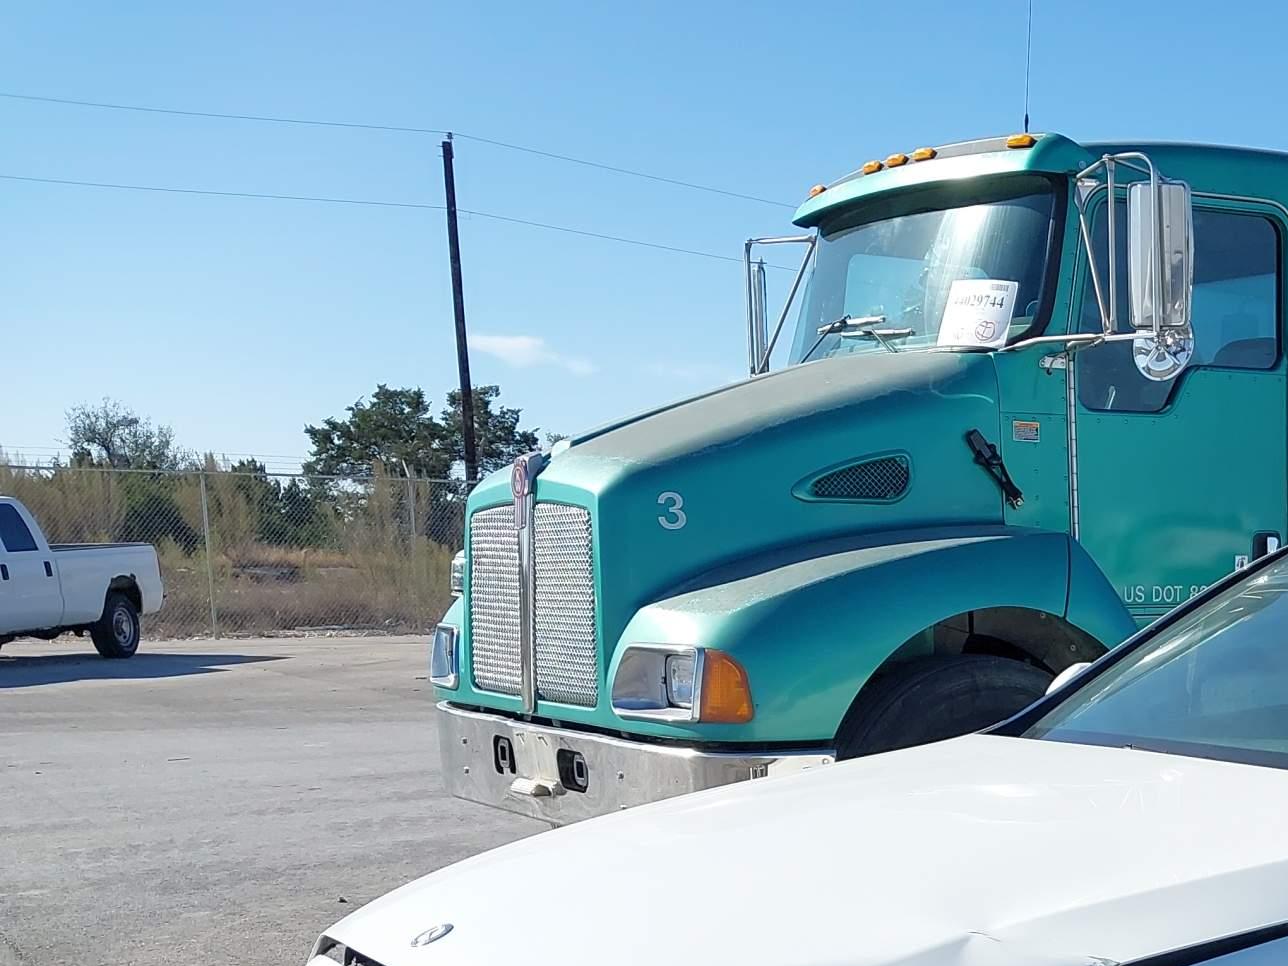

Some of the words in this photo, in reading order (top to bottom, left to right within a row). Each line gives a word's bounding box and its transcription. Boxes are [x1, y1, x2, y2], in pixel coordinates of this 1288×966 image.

[657, 491, 687, 530] 3
[1124, 585, 1145, 602] US
[1152, 585, 1183, 602] DOT
